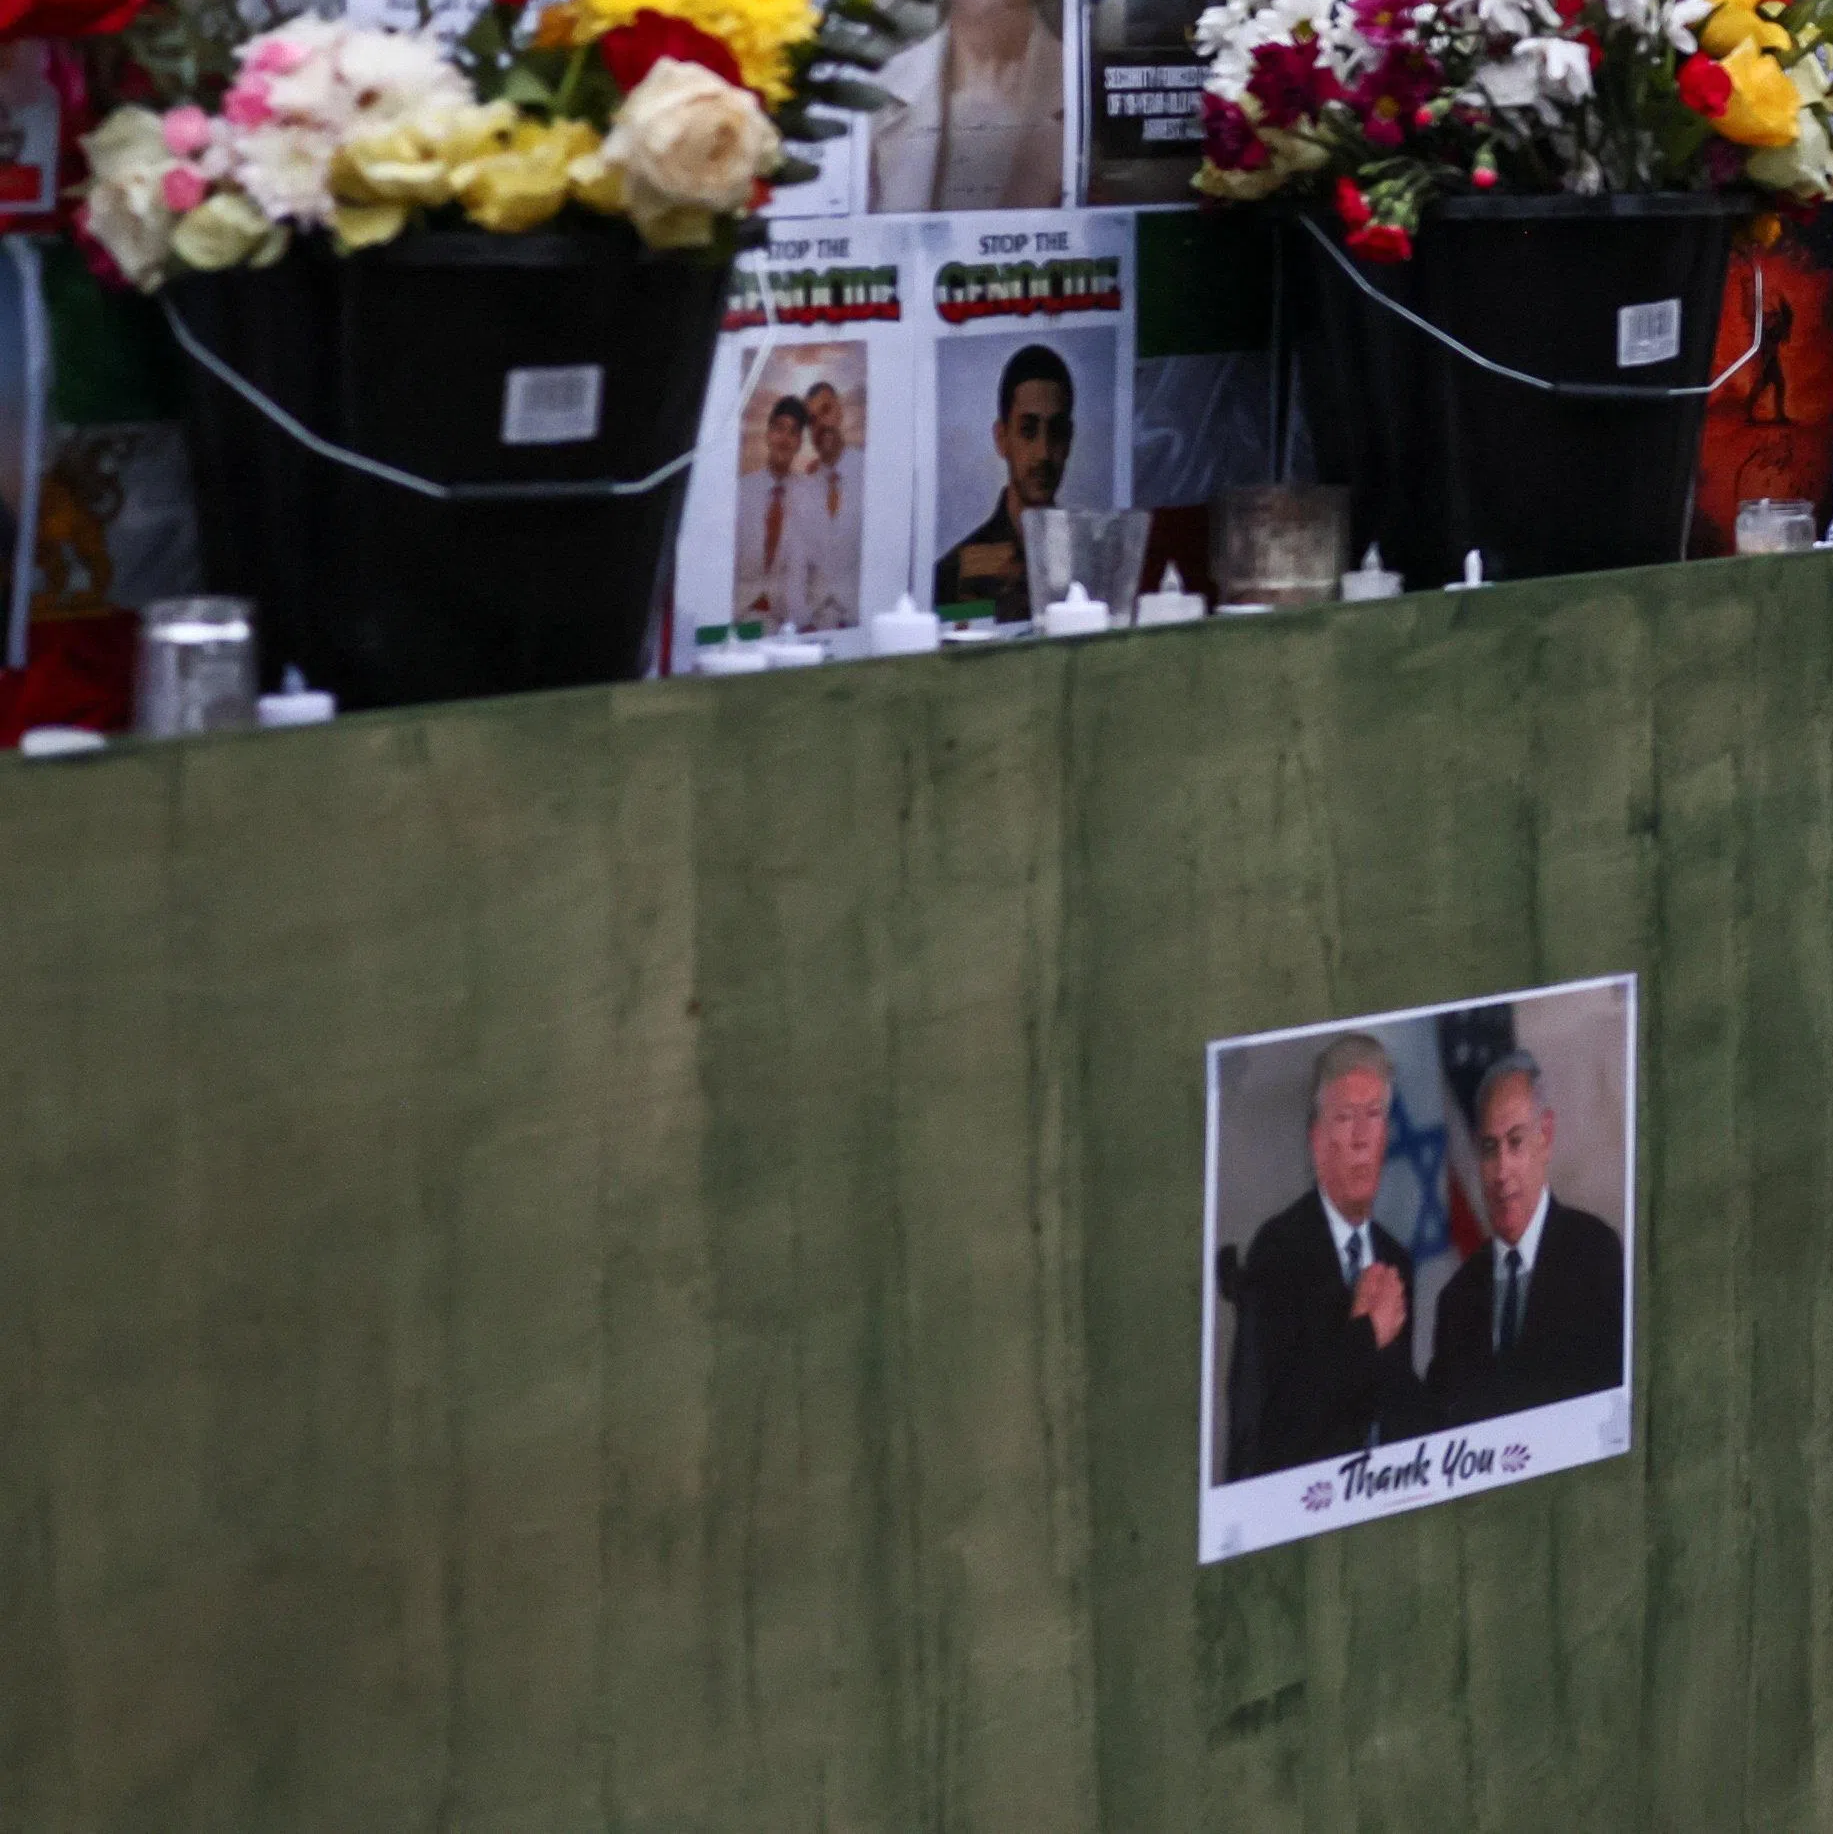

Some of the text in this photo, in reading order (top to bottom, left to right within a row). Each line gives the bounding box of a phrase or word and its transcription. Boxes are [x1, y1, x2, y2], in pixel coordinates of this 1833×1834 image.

[818, 237, 851, 257] THE
[978, 231, 1070, 256] STOP THE
[1337, 1438, 1496, 1501] Thank You
